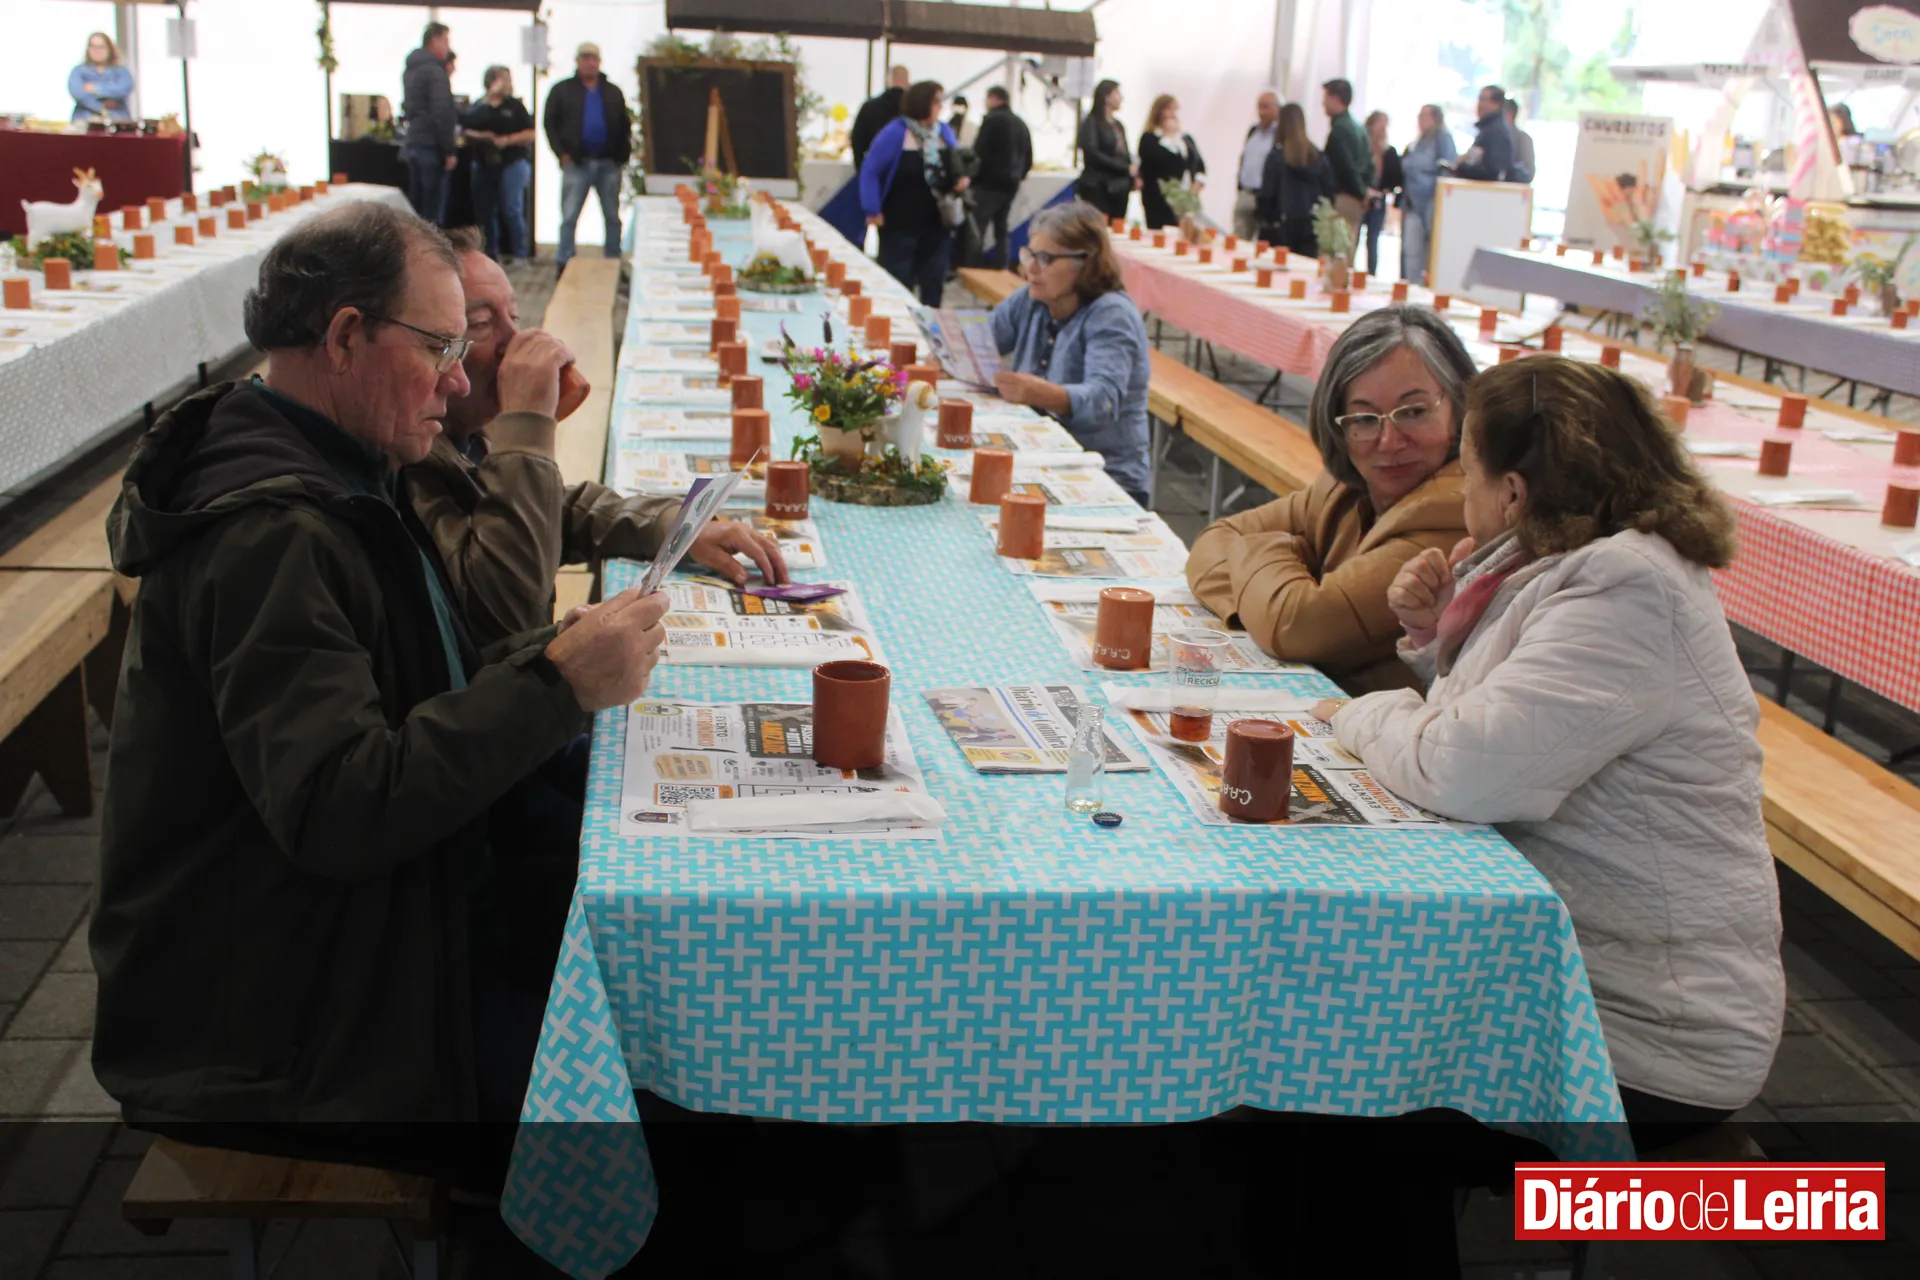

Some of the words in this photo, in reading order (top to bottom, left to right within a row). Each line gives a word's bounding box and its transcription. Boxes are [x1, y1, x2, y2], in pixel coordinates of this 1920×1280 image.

[1008, 686, 1043, 710] Diário
[716, 716, 728, 737] EVENTO
[1024, 710, 1049, 719] de
[760, 720, 786, 754] AMIZADE
[1031, 719, 1068, 748] Coimbra
[1348, 783, 1381, 809] EVENTO
